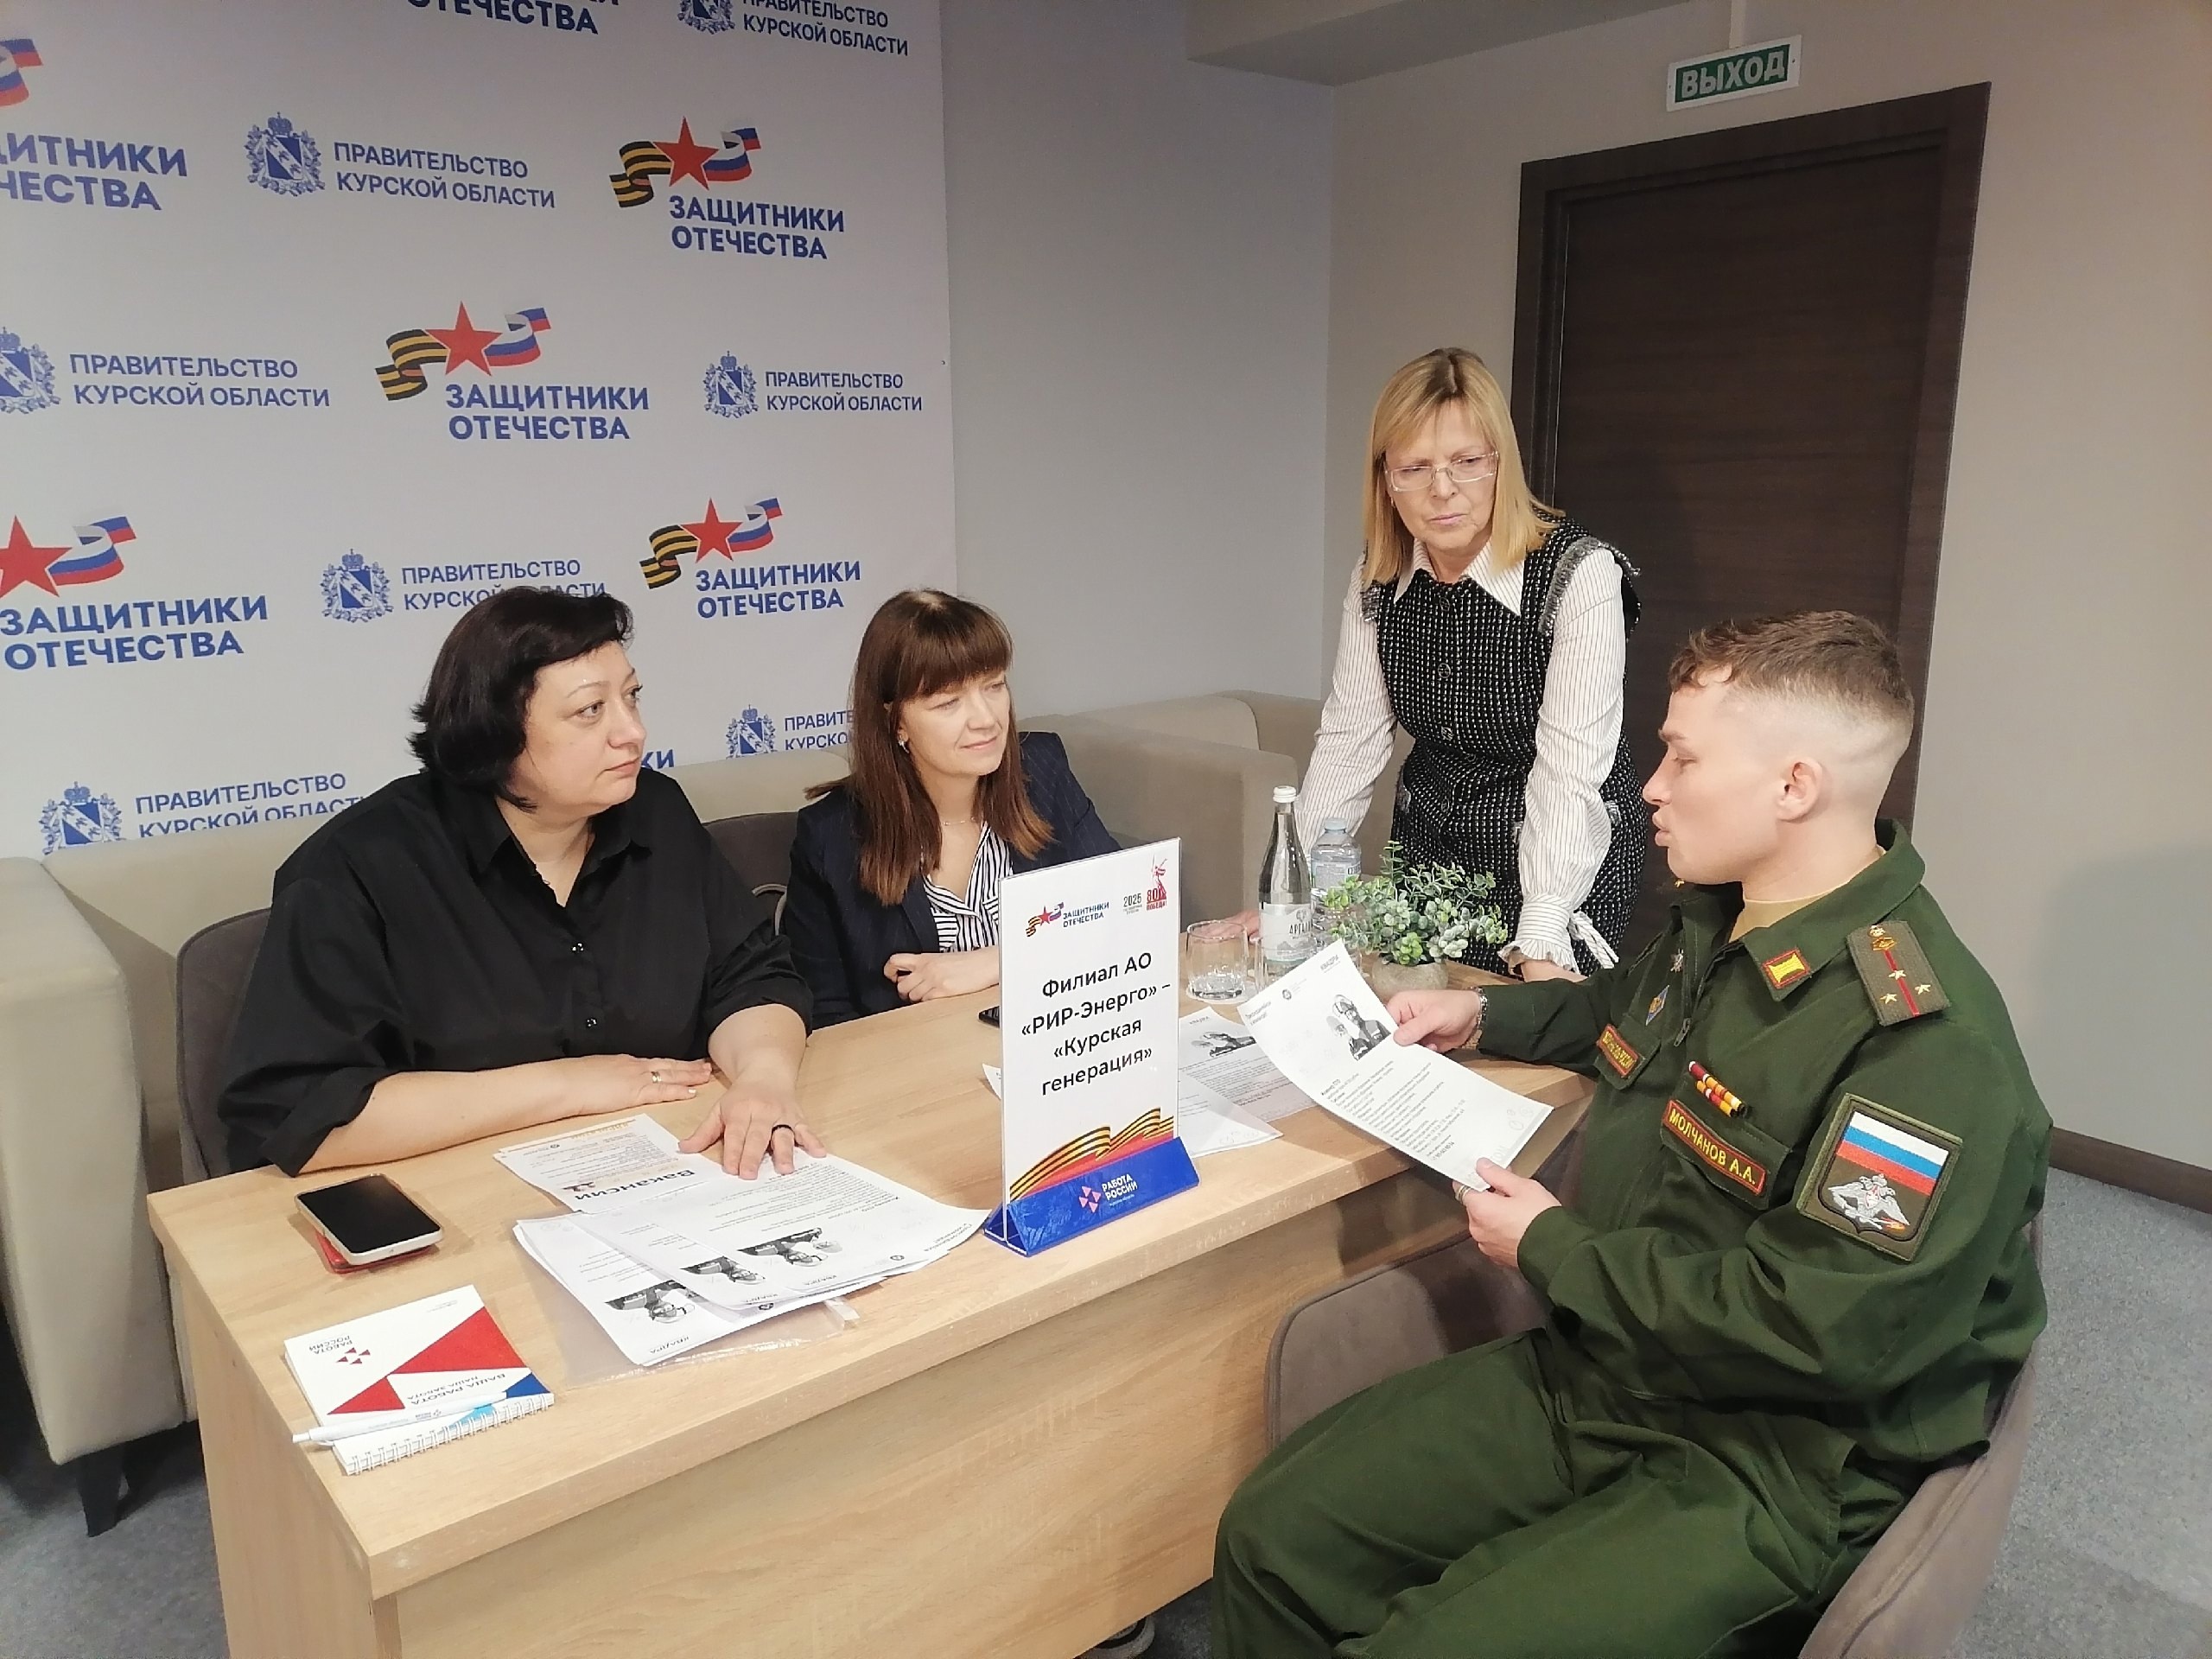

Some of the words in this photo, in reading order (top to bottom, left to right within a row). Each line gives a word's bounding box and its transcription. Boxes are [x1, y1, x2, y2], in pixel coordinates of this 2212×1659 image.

[408, 0, 599, 35] ЕЧЕСТВА
[743, 14, 827, 43] КУРСКОЙ
[830, 29, 908, 56] ОБЛАСТИ
[1681, 50, 1786, 99] ВЫХОД
[0, 132, 187, 177] ИТНИКИ
[334, 143, 528, 178] ПРАВИТЕЛЬСТВО
[336, 172, 448, 200] КУРСКОЙ
[452, 183, 556, 208] ОБЛАСТИ
[669, 195, 844, 232] ЗАЩИТНИКИ
[671, 226, 827, 259] ОТЕЧЕСТВА
[70, 354, 298, 378] ПРАВИТЕЛЬСТВО
[766, 372, 904, 390] ПРАВИТЕЛЬСТВО
[74, 383, 205, 406] КУРСКОЙ
[210, 388, 330, 407] ОБЛАСТИ
[445, 384, 649, 410] ЗАЩИТНИКИ
[766, 391, 845, 411] КУРСКОЙ
[848, 395, 923, 411] ОБЛАСТИ
[448, 416, 630, 439] ОТЕЧЕСТВА
[402, 560, 581, 584] ПРАВИТЕЛЬСТВО
[695, 561, 861, 591] ЗАЩИТНИКИ
[0, 595, 268, 635] ЗАЩИТНИКИ
[697, 588, 844, 619] ОТЕЧЕСТВА
[4, 630, 245, 671] ОТЕЧЕСТВА
[136, 773, 346, 814] ПРАВИТЕЛЬСТВО
[138, 805, 258, 838] КУРСКОЙ
[1063, 901, 1109, 919] ЗАЩИТНИКИ
[1123, 893, 1142, 907] 2025
[1063, 912, 1104, 928] ОТЕЧЕСТВА
[1042, 964, 1118, 998] Филиал
[1124, 952, 1152, 974] АО
[1021, 985, 1157, 1035] «РИР-Энерго»
[1053, 1020, 1141, 1058] «Курская
[1042, 1048, 1152, 1096] генерация»
[1669, 1109, 1726, 1166] МОЛЧАНОВ
[1729, 1159, 1756, 1185] А.А.
[575, 1169, 696, 1201] Вакансии
[1102, 1173, 1133, 1192] РАБОТА
[1105, 1181, 1138, 1200] РОССИИ
[410, 1386, 464, 1405] РАБОТА
[466, 1373, 506, 1389] ВАША
